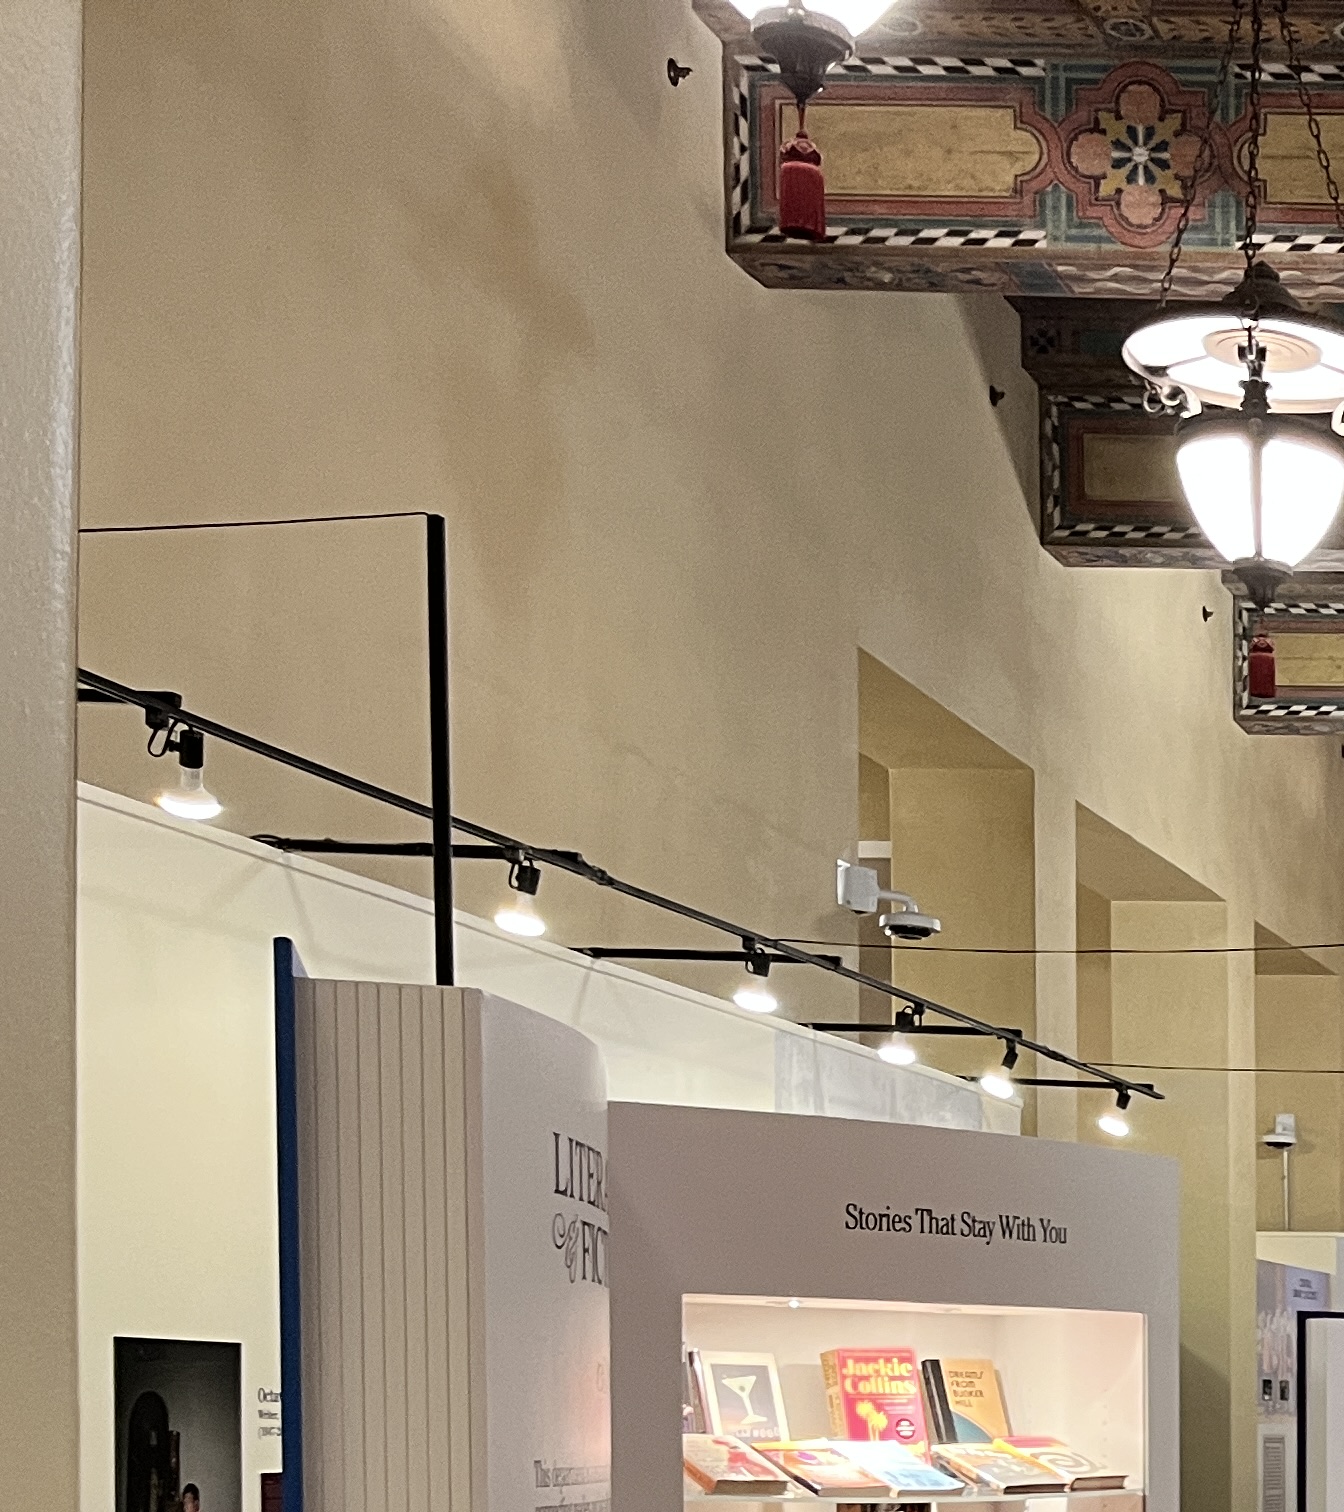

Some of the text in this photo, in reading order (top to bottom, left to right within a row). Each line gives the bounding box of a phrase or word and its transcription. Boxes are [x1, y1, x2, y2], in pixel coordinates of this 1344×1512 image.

[845, 1203, 1067, 1246] Stories That Stay With You
[842, 1357, 913, 1377] Jackie
[844, 1376, 917, 1395] Collins
